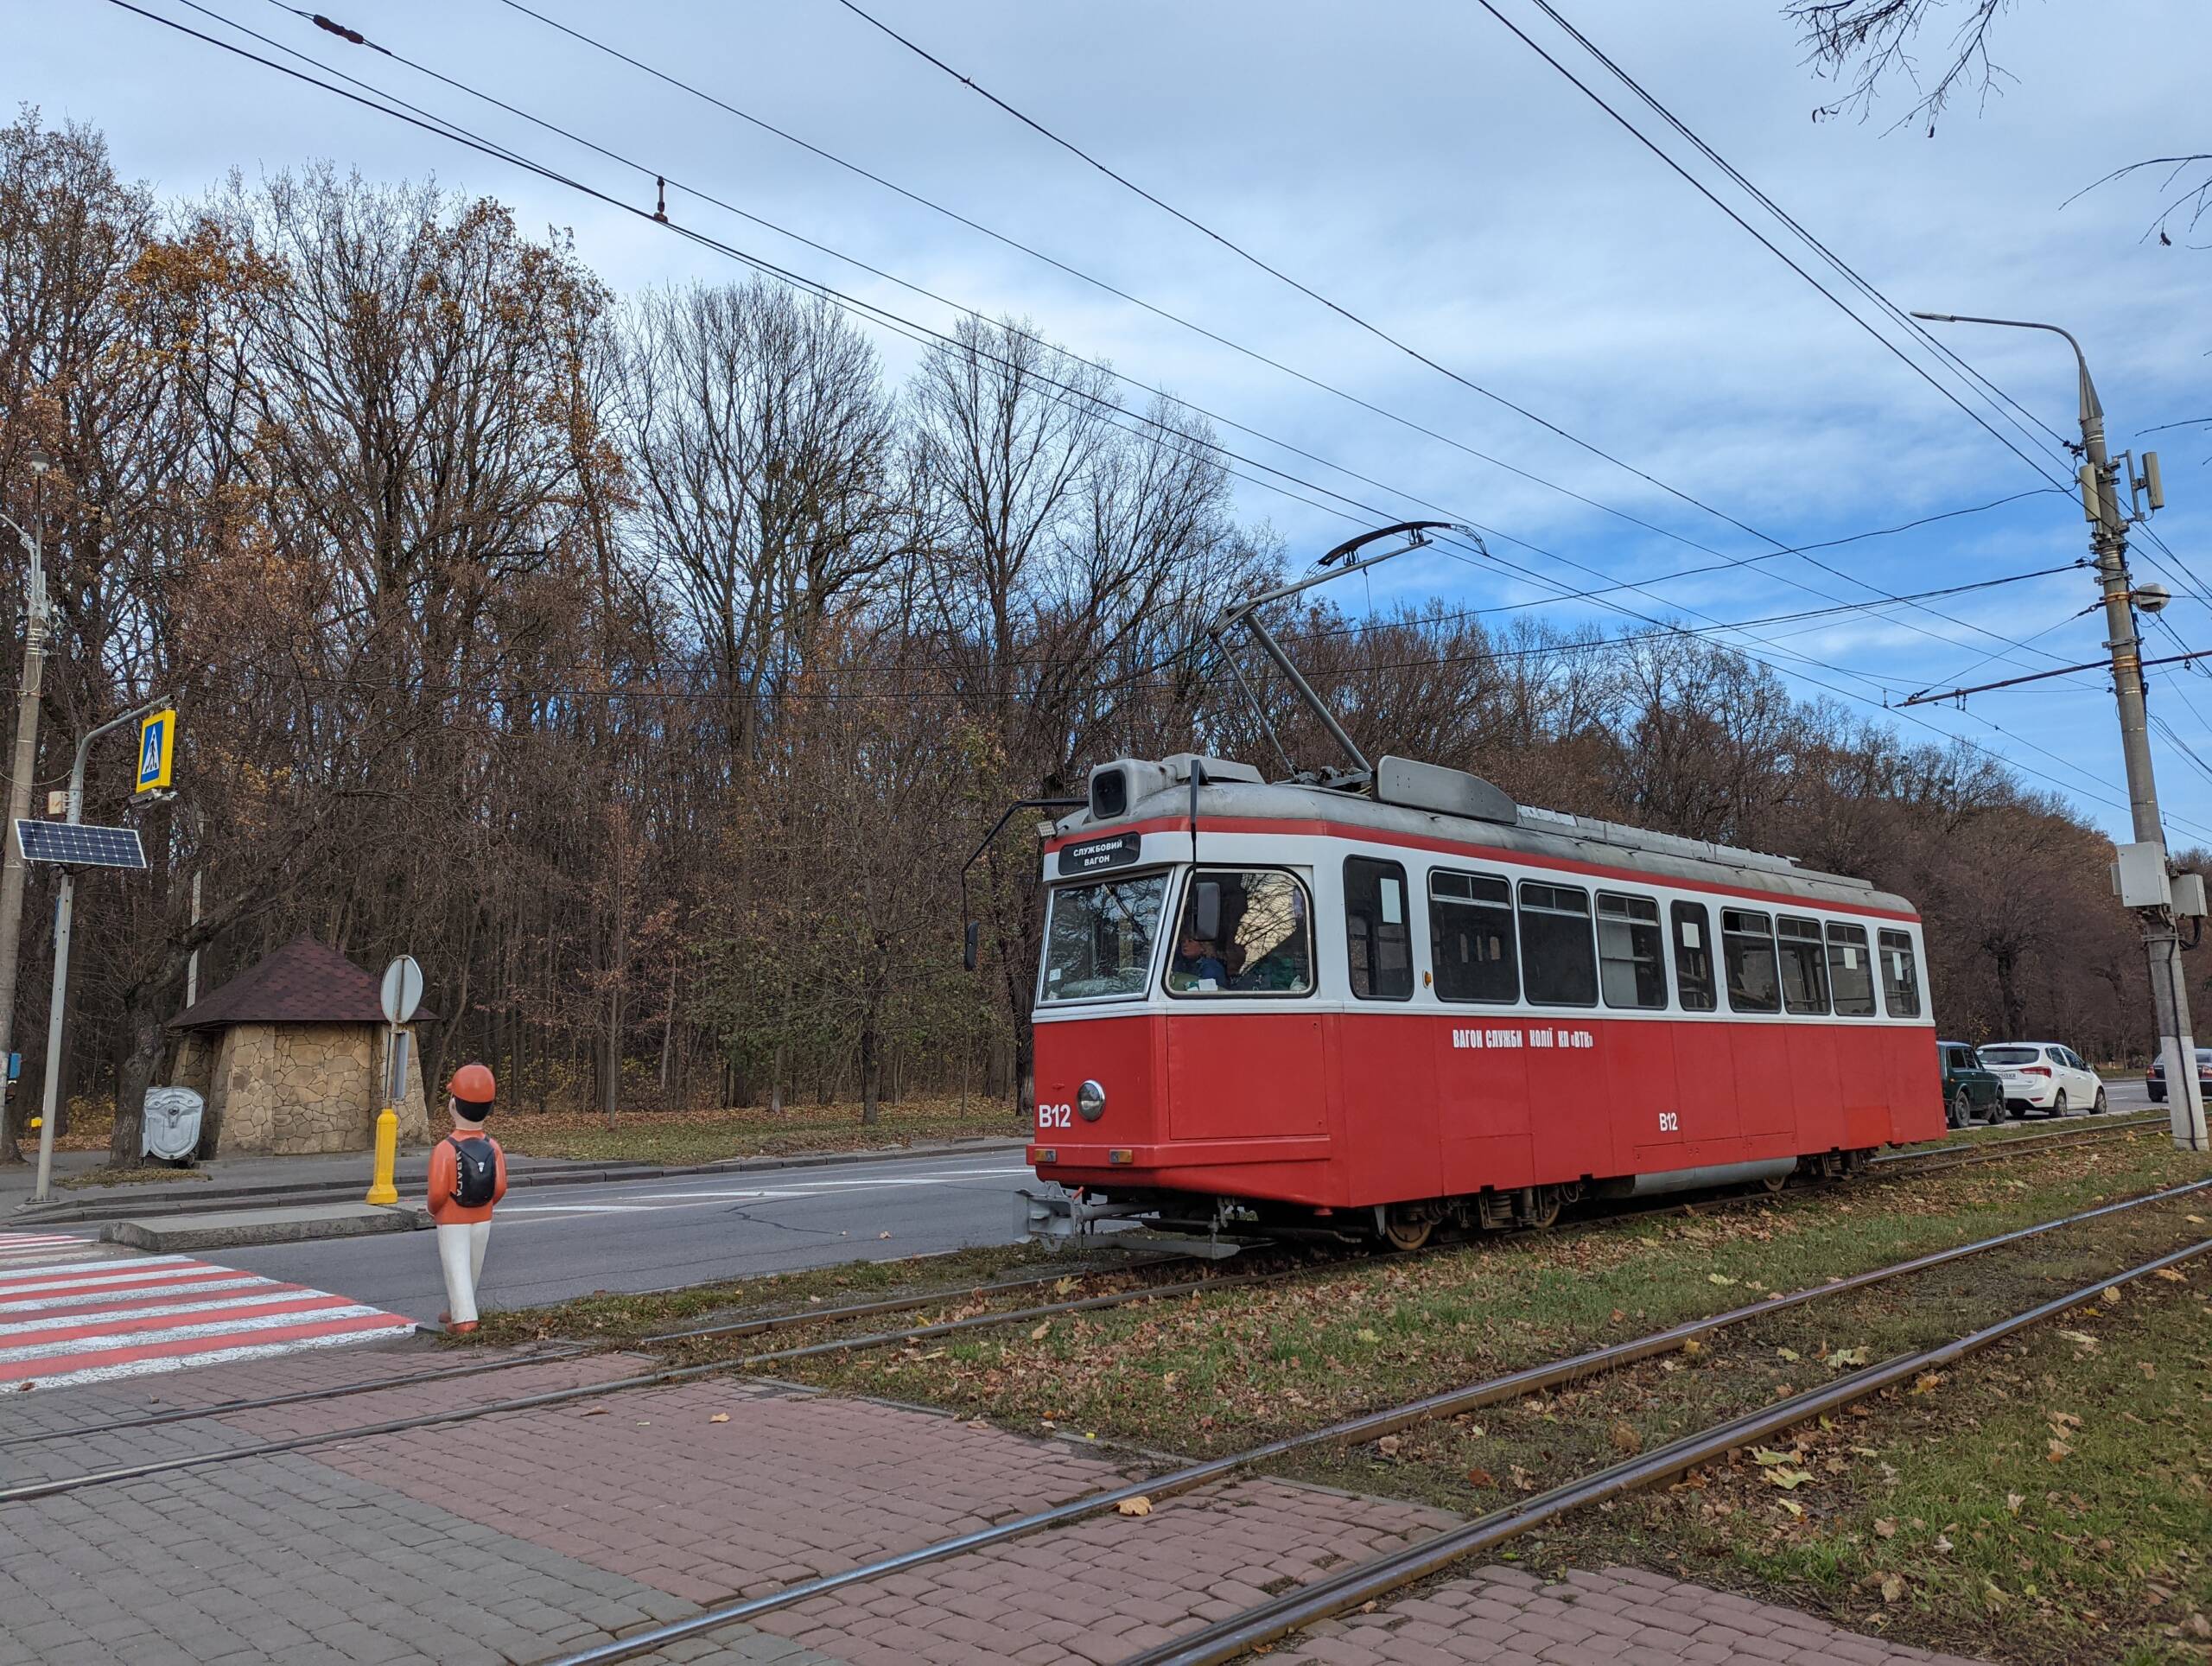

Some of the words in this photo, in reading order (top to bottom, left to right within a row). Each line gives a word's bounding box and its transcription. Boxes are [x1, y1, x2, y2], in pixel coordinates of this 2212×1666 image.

[1073, 839, 1122, 857] СЛУЖБОВИЙ
[1084, 855, 1110, 867] ВАГОН
[1452, 1029, 1484, 1048] ВАГОН
[1485, 1029, 1523, 1048] СЛУЖБИ
[1529, 1027, 1554, 1048] КОЛІЇ
[1557, 1030, 1570, 1048] КП
